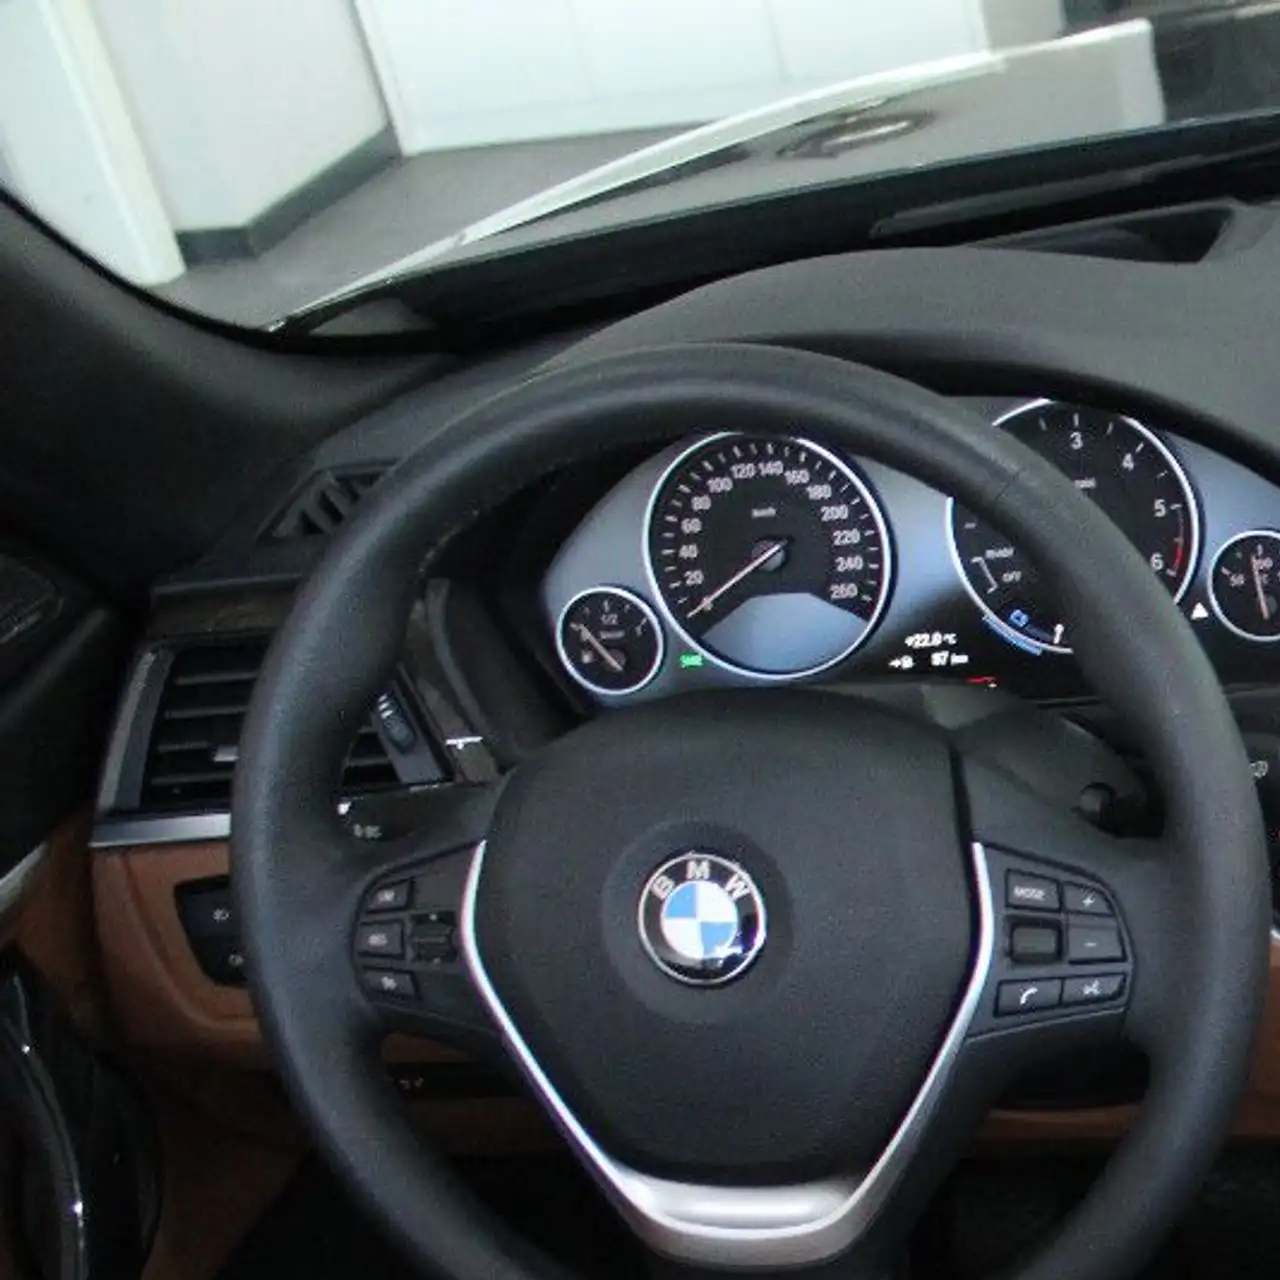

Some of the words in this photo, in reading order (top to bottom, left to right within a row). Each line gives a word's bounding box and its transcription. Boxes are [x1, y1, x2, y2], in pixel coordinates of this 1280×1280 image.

[1070, 432, 1083, 450] 3
[758, 460, 784, 476] 140
[1122, 453, 1134, 471] 4
[730, 463, 756, 479] 120
[784, 469, 810, 486] 160
[707, 476, 733, 493] 100
[806, 484, 832, 500] 180
[691, 495, 711, 511] 80
[1154, 499, 1166, 517] 5
[820, 505, 849, 522] 200
[681, 518, 702, 533] 60
[833, 528, 861, 545] 220
[679, 543, 698, 559] 40
[835, 556, 864, 572] 240
[1152, 552, 1163, 571] 6
[684, 570, 704, 585] 20
[830, 583, 858, 599] 260
[651, 860, 751, 901] BMW
[1014, 885, 1045, 901] MODE
